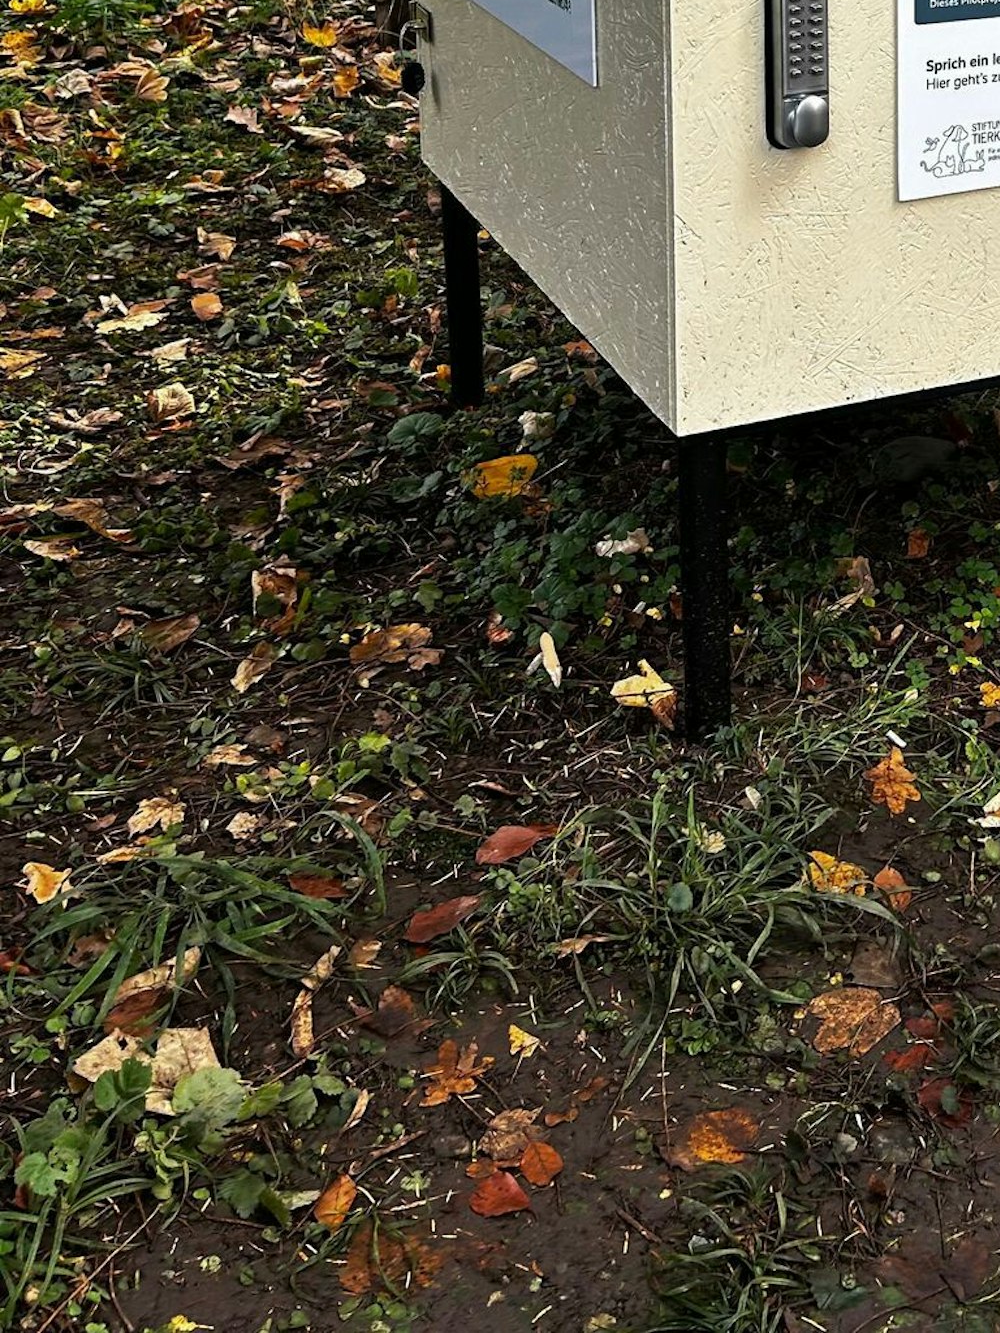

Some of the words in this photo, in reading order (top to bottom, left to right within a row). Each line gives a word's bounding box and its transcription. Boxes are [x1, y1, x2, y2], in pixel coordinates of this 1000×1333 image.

[926, 56, 966, 75] Sprich
[970, 54, 988, 67] ein
[926, 77, 951, 90] Hier
